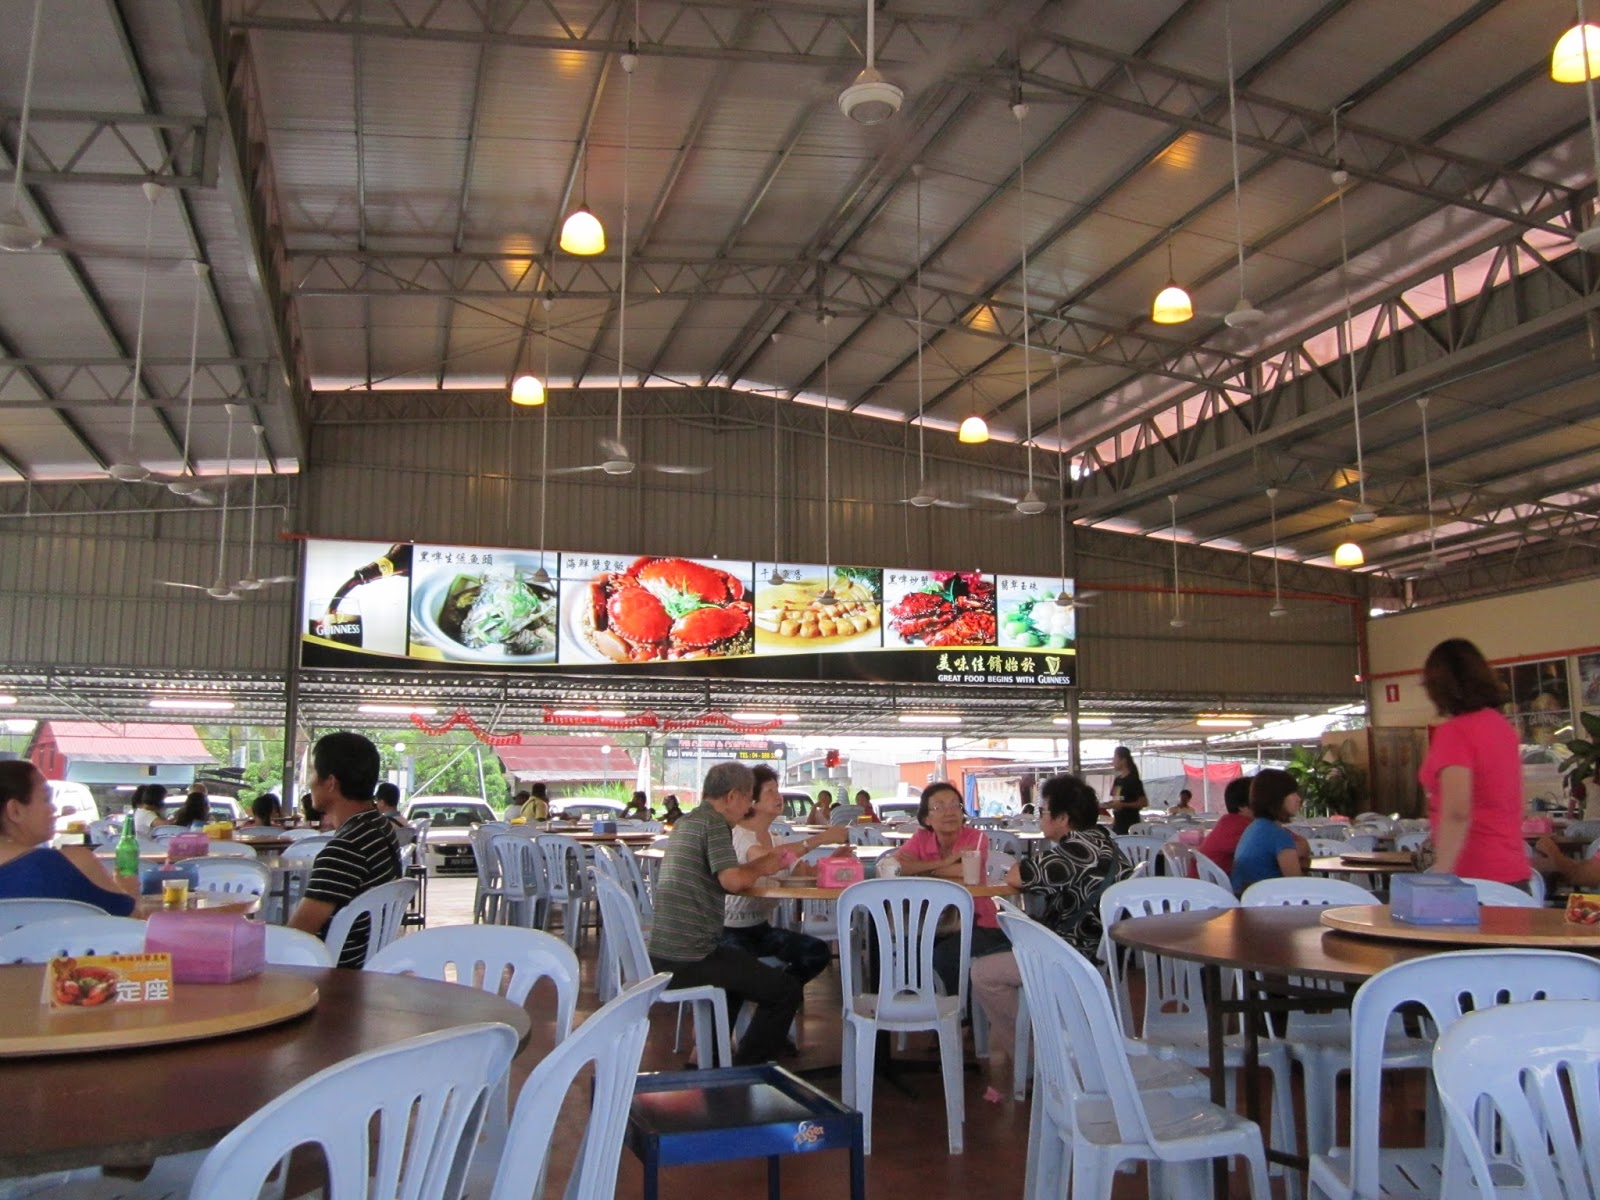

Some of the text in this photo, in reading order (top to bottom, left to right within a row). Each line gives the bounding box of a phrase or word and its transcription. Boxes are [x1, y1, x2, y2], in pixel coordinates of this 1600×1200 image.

[316, 624, 360, 636] GUINNESS
[938, 674, 961, 682] GREAT
[964, 675, 985, 683] FOOD
[987, 675, 1013, 683] BEGINS
[1037, 675, 1070, 684] GUINNESS
